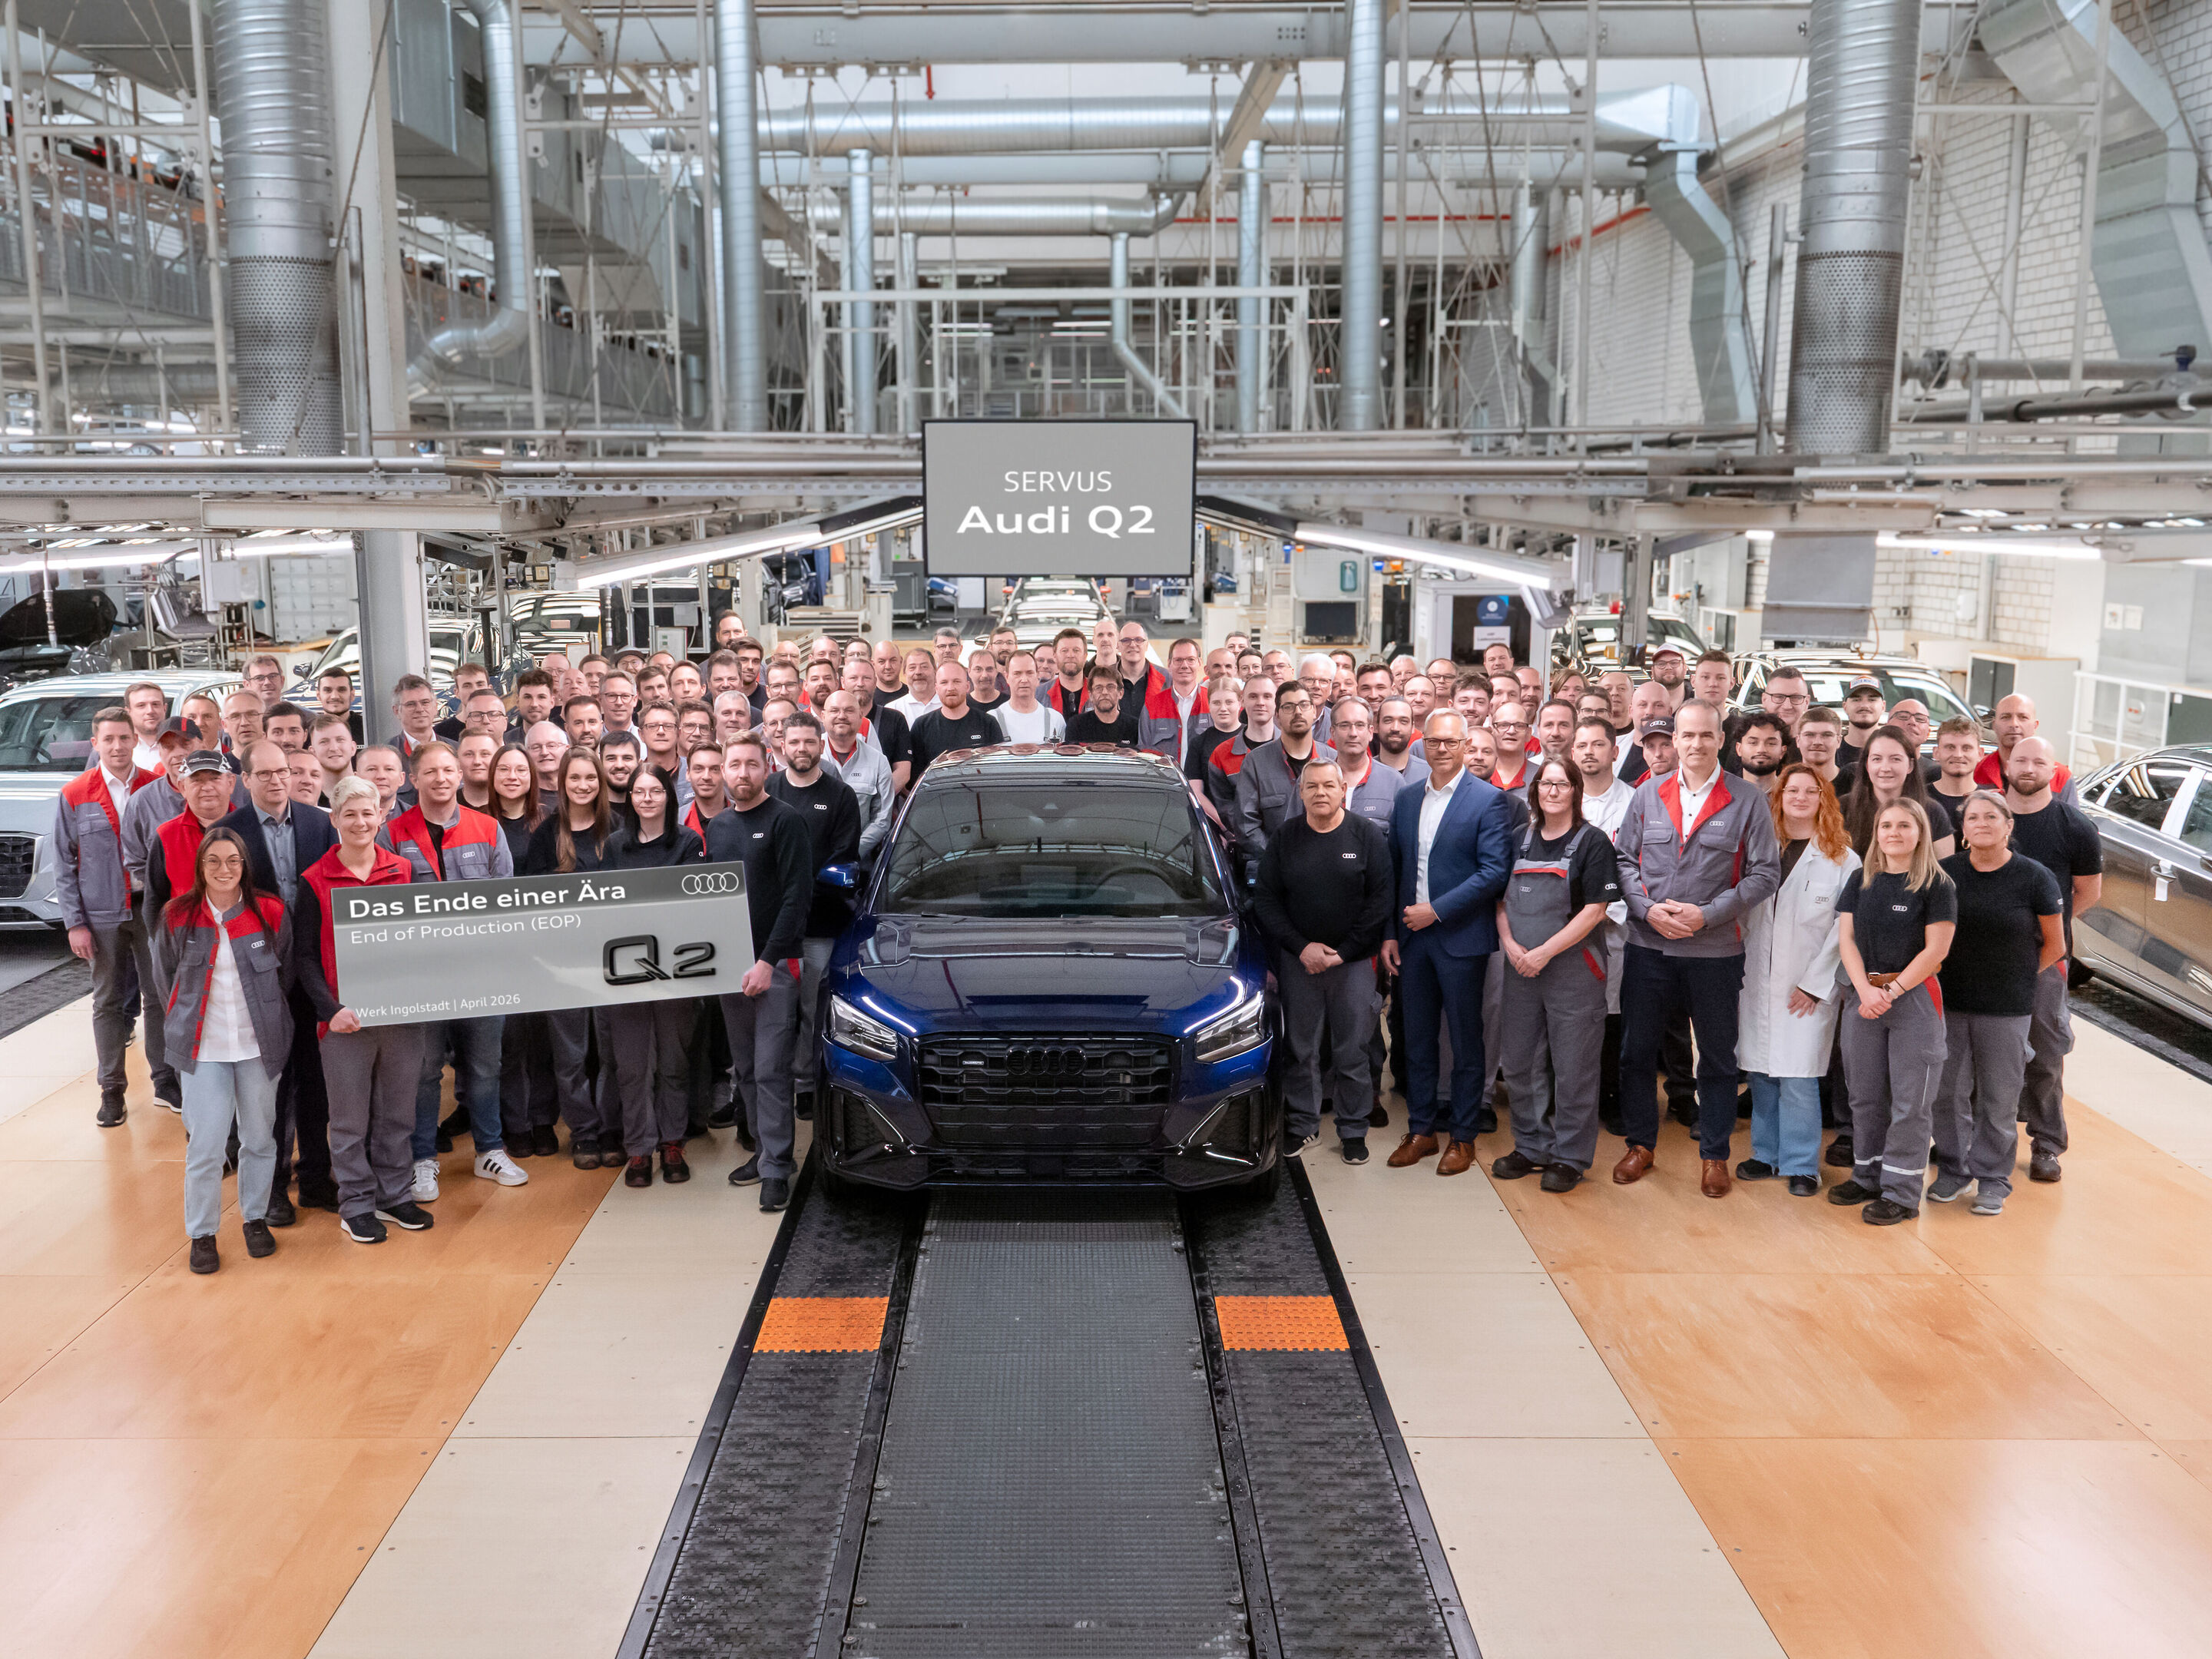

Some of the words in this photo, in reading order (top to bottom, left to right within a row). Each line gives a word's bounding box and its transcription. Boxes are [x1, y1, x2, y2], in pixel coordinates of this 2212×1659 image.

[1004, 470, 1113, 492] SERVUS
[955, 505, 1070, 534] Audi
[1088, 505, 1156, 539] Q2
[349, 899, 405, 919] Das
[413, 892, 488, 914] Ende
[496, 888, 569, 908] einer
[577, 879, 626, 902] Ära
[350, 929, 388, 945] End
[394, 926, 416, 942] of
[420, 920, 525, 939] Production
[531, 914, 582, 932] (EOP)
[602, 934, 717, 986] Q2
[355, 1005, 387, 1018] Werk
[390, 1000, 451, 1017] Ingolstadt
[459, 996, 488, 1011] April
[489, 993, 522, 1007] 2026
